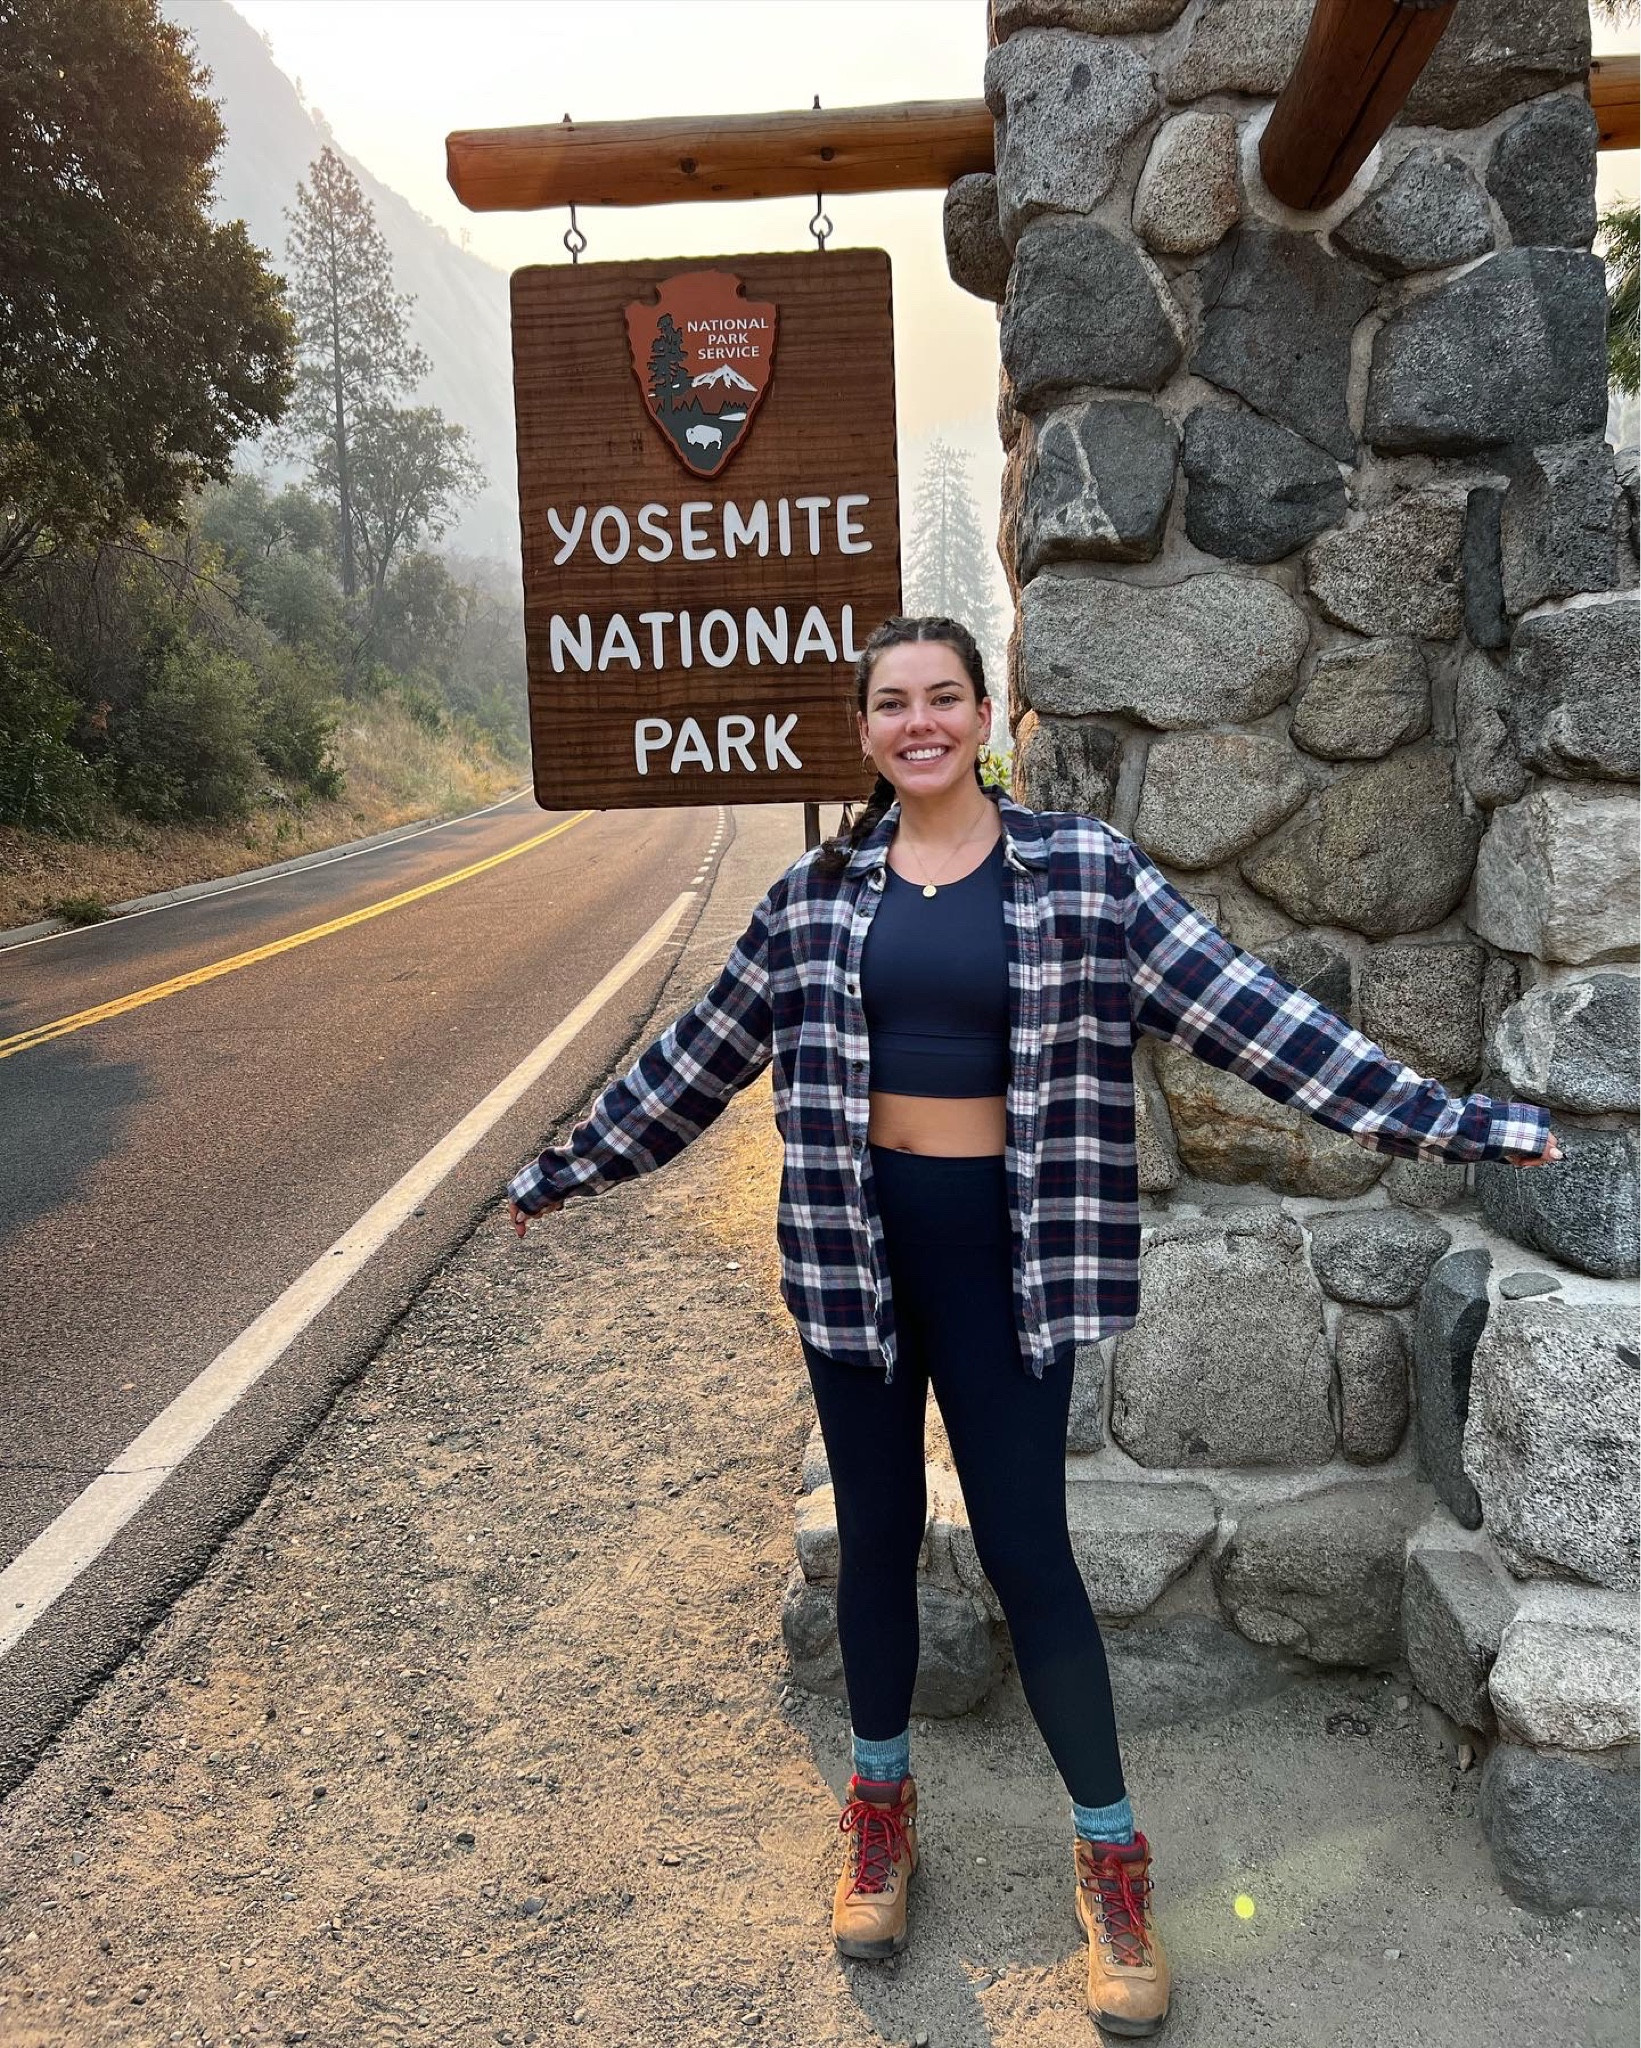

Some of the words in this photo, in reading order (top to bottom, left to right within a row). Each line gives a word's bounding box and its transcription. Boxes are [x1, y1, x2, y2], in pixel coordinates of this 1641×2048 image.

[687, 317, 769, 333] NATIONAL
[707, 332, 749, 345] PARK
[697, 345, 760, 360] SERVICE
[547, 494, 873, 566] YOSEMITE
[549, 604, 866, 673] NATIONAL
[634, 713, 803, 775] PARK
